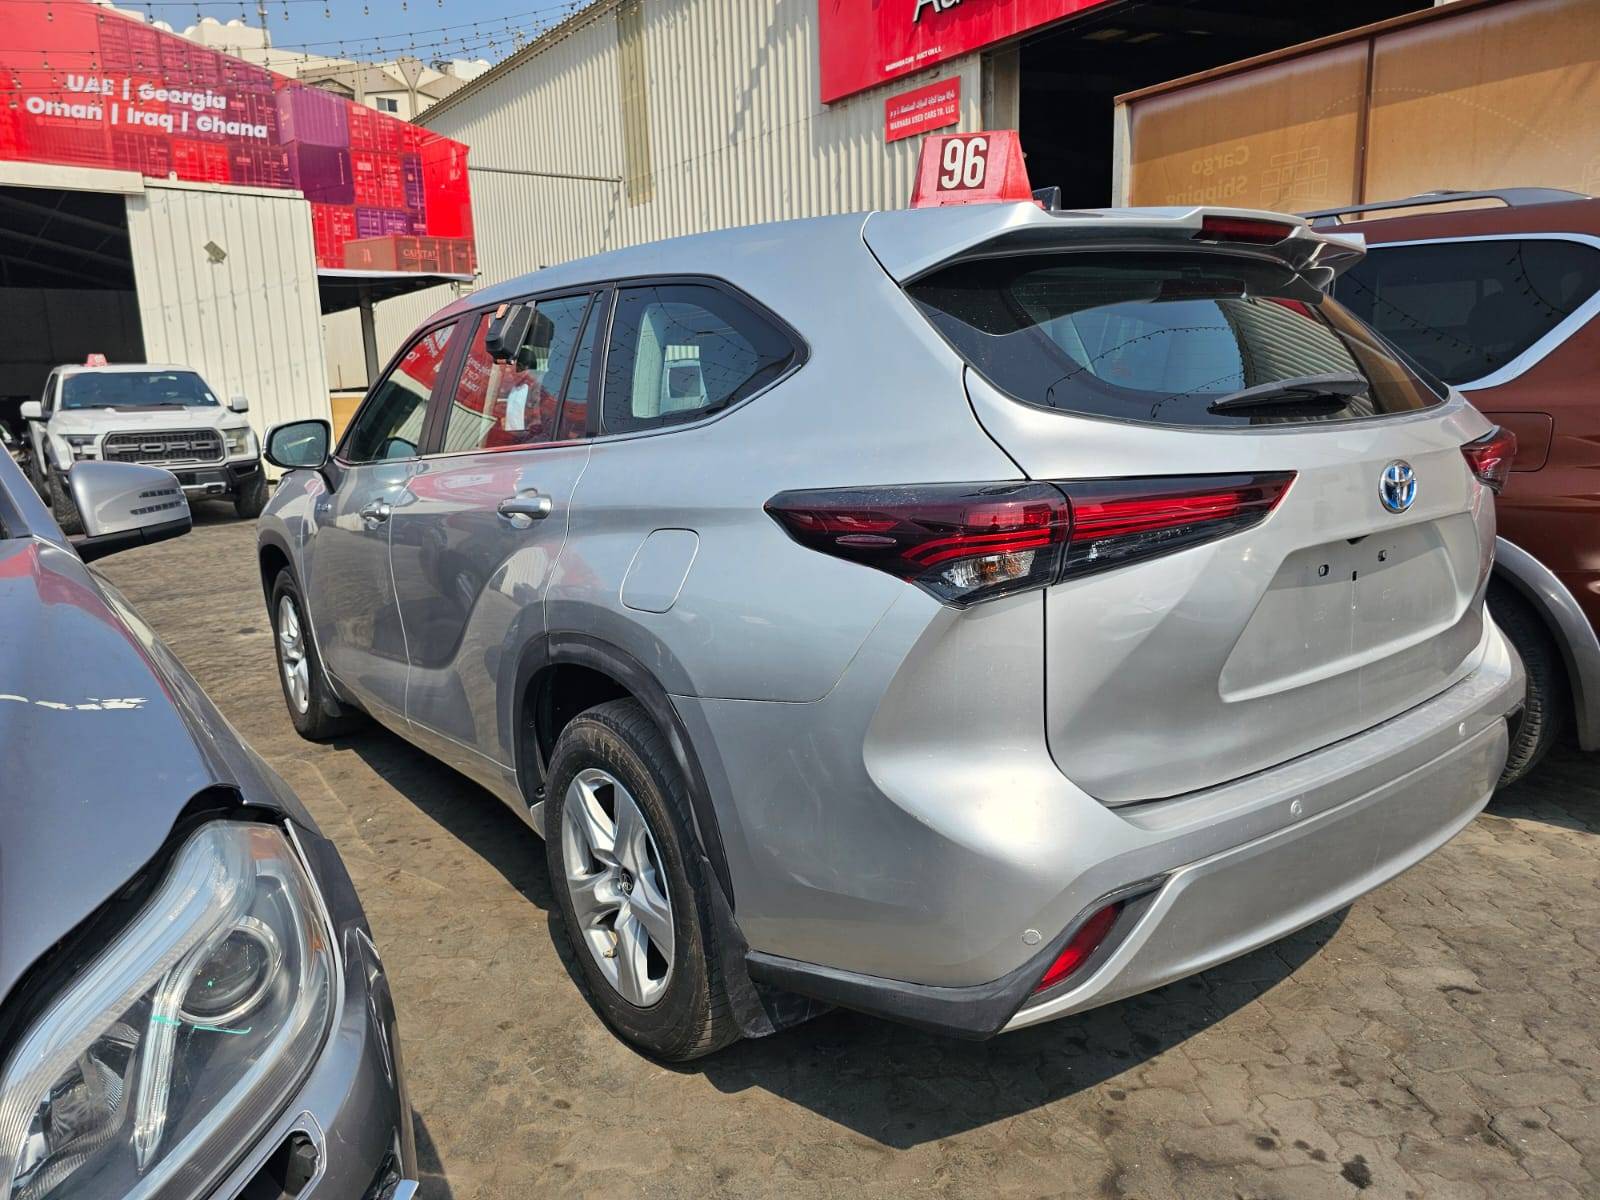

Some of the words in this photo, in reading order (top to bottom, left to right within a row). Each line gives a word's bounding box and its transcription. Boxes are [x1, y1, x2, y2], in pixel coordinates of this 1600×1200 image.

[66, 73, 114, 96] UAE
[138, 83, 227, 110] Georgia
[945, 104, 955, 114] LLC
[25, 96, 103, 121] Oman
[126, 107, 174, 133] Iraq
[196, 115, 268, 138] Ghana
[941, 136, 987, 189] 96
[105, 440, 216, 455] FORD
